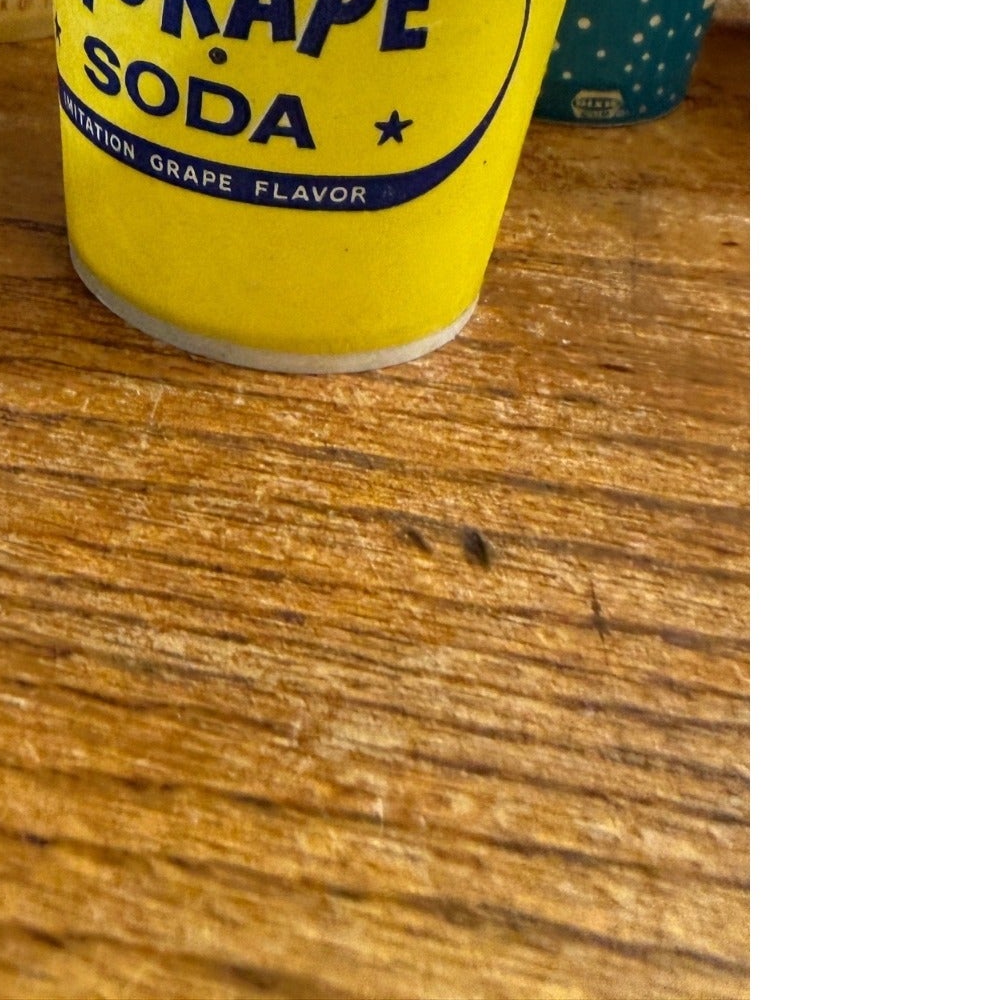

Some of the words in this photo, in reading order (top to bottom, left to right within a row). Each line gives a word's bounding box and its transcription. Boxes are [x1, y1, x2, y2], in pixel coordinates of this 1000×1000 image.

[63, 94, 136, 160] IMITATION
[150, 154, 232, 192] GRAPE
[255, 180, 366, 203] FLAVOR
[84, 35, 316, 150] SODA
